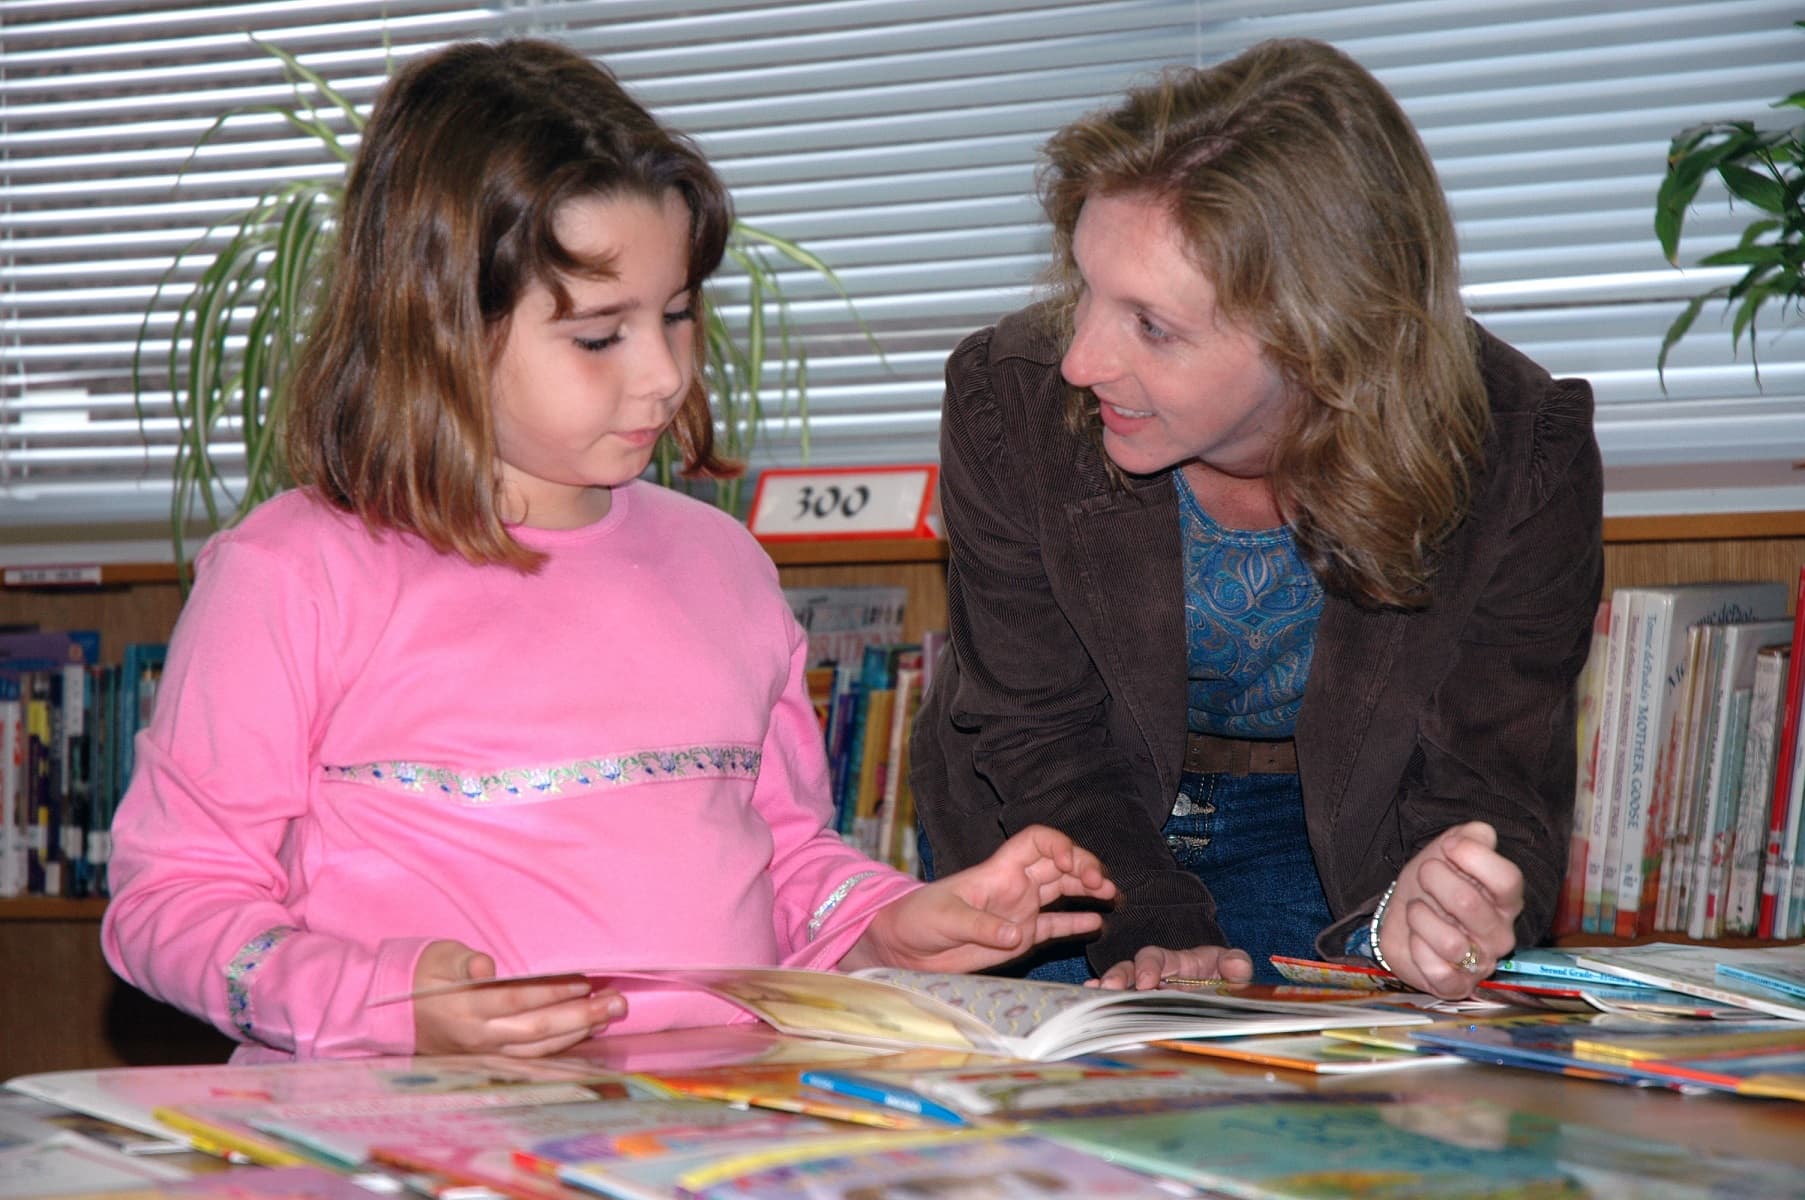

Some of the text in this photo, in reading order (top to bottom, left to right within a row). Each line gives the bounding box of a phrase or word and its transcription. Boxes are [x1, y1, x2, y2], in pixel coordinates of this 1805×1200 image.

[792, 485, 871, 520] 300
[1632, 703, 1649, 775] MOTHER
[1628, 776, 1643, 831] GOOSE
[1539, 964, 1568, 977] Second
